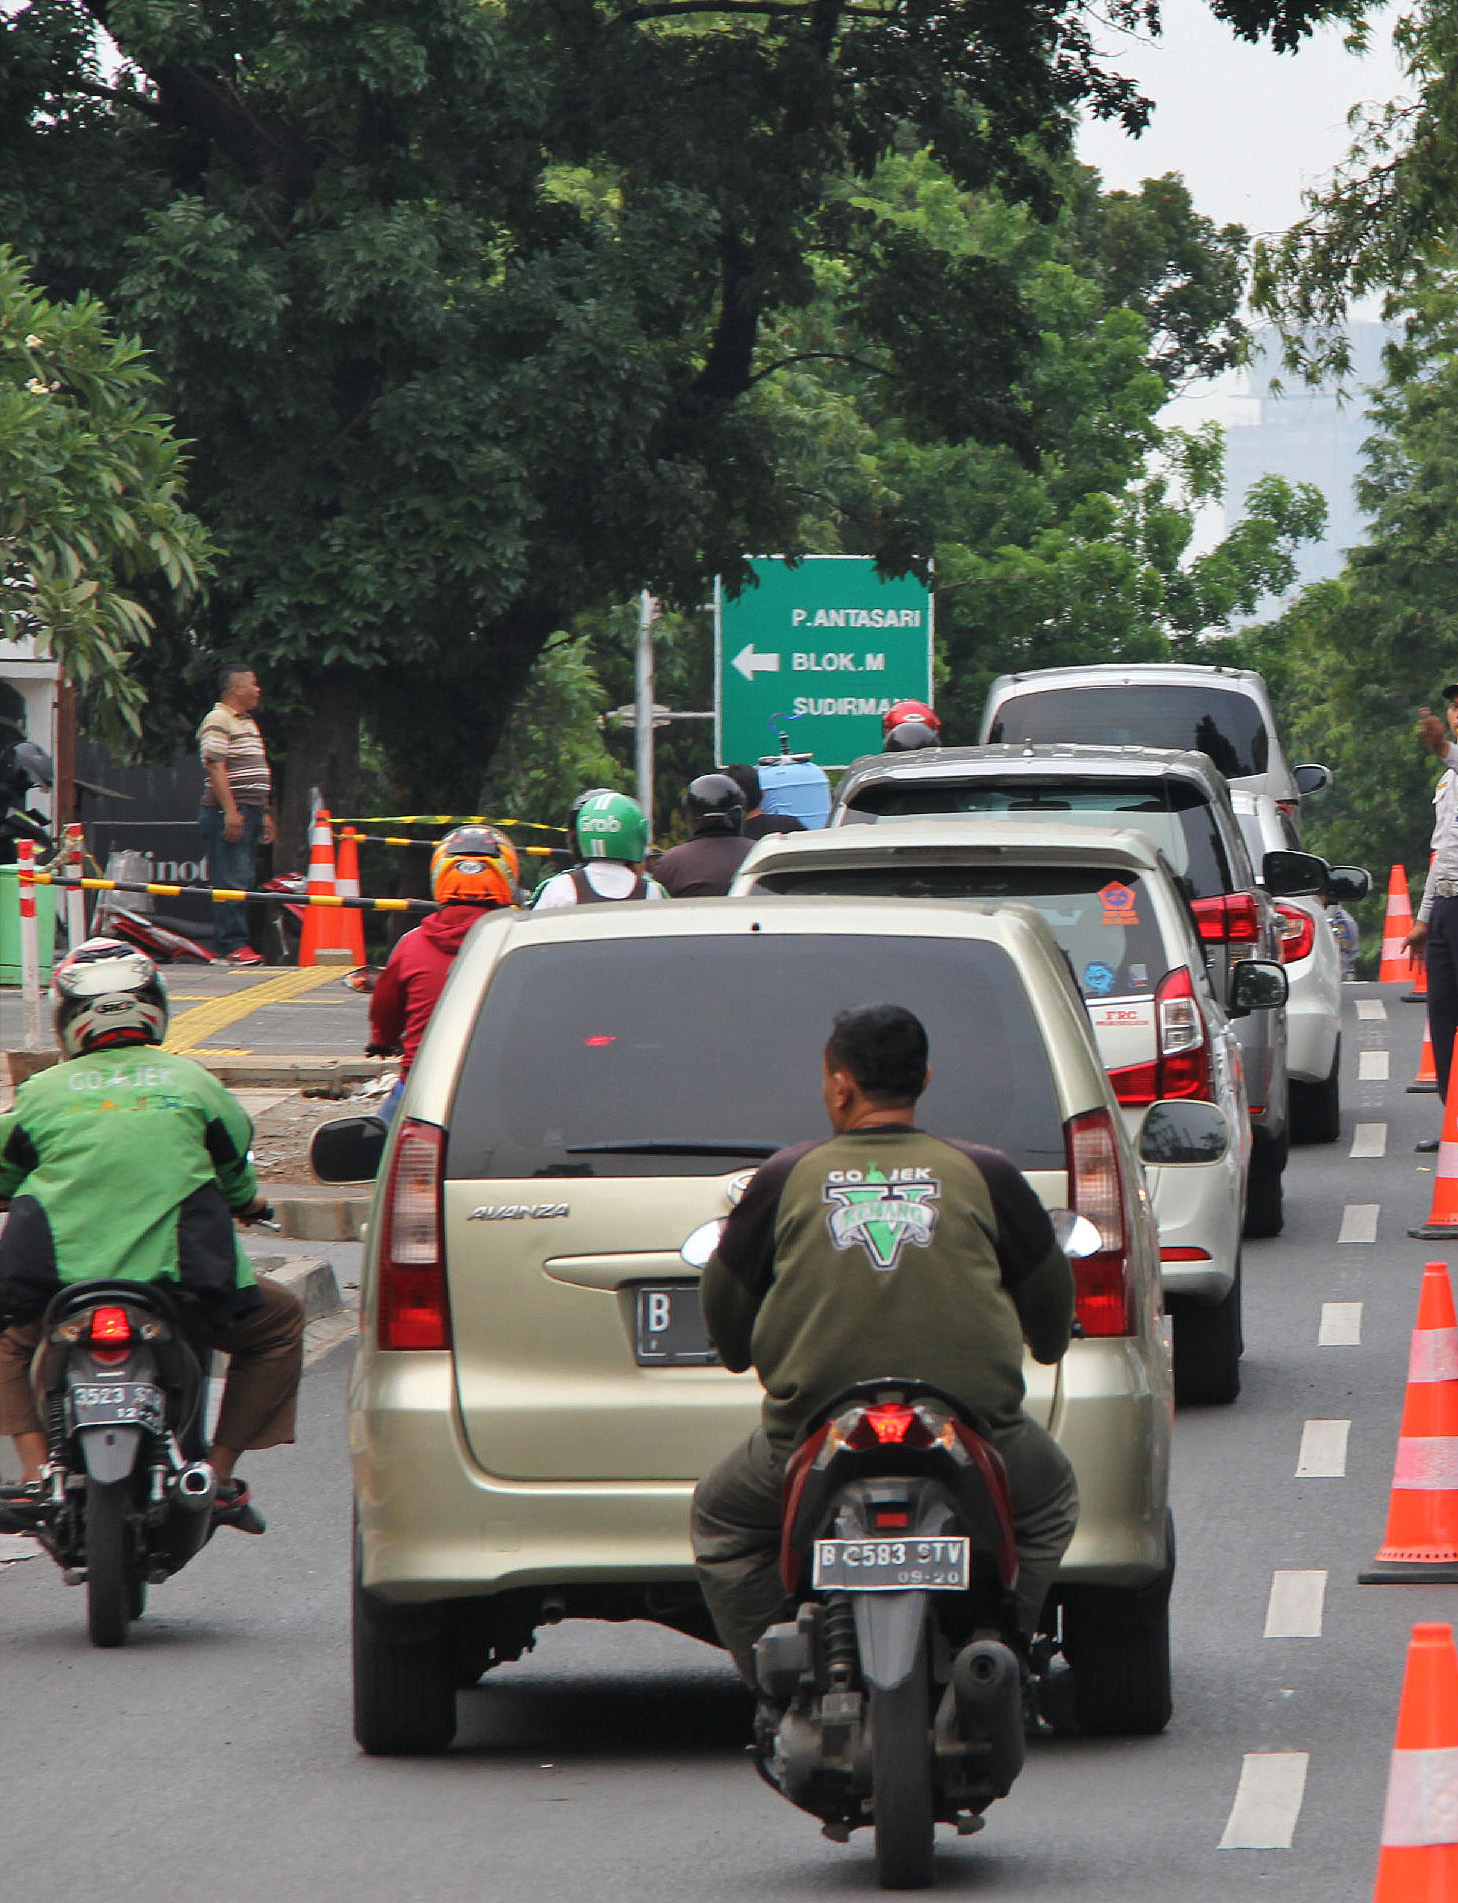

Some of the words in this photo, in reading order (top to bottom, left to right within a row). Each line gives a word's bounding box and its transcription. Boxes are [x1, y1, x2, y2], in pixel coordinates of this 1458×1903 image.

[792, 608, 921, 628] P.ANTASARI
[792, 652, 886, 671] BLOK.M
[793, 696, 908, 716] SUDIRMA
[579, 815, 621, 833] Grab
[69, 1070, 104, 1092] GO
[133, 1066, 177, 1087] JEK
[828, 1168, 864, 1184] GO
[889, 1167, 932, 1181] JEK
[466, 1203, 570, 1221] AVANZA
[648, 1293, 671, 1333] B
[821, 1545, 836, 1567] B
